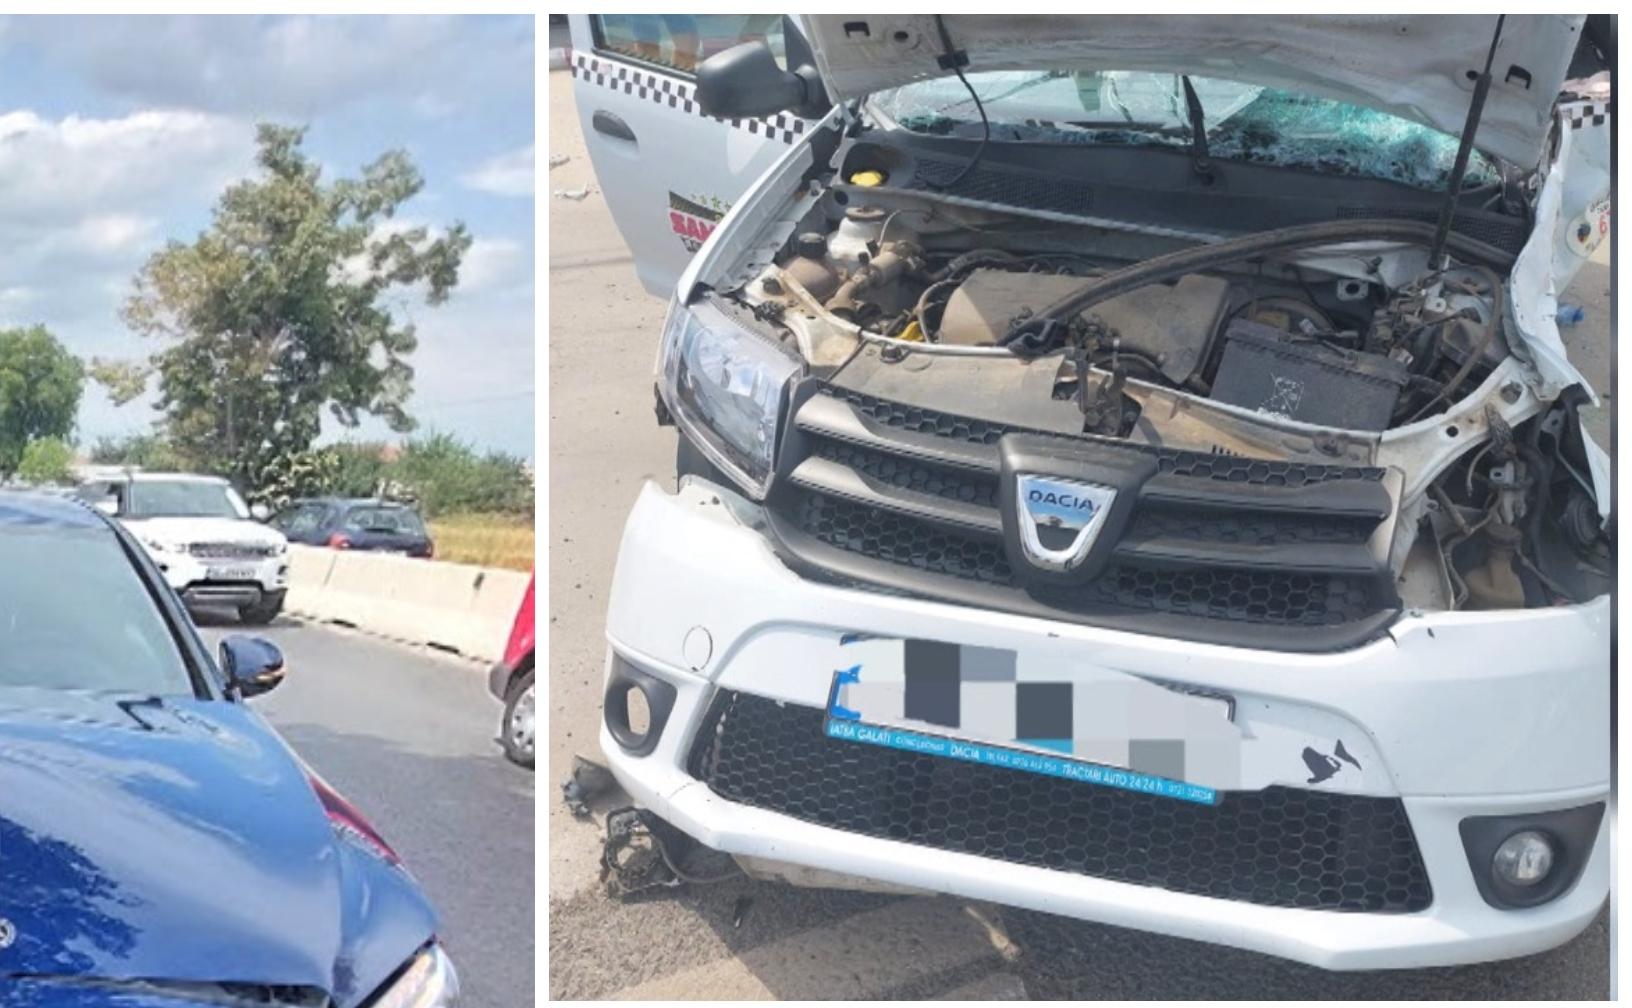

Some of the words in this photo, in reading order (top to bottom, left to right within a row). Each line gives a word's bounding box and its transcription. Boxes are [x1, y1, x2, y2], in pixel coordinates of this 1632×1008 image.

[1028, 489, 1095, 512] DACIA
[950, 743, 980, 760] DACIA
[1103, 769, 1127, 786] AUTO
